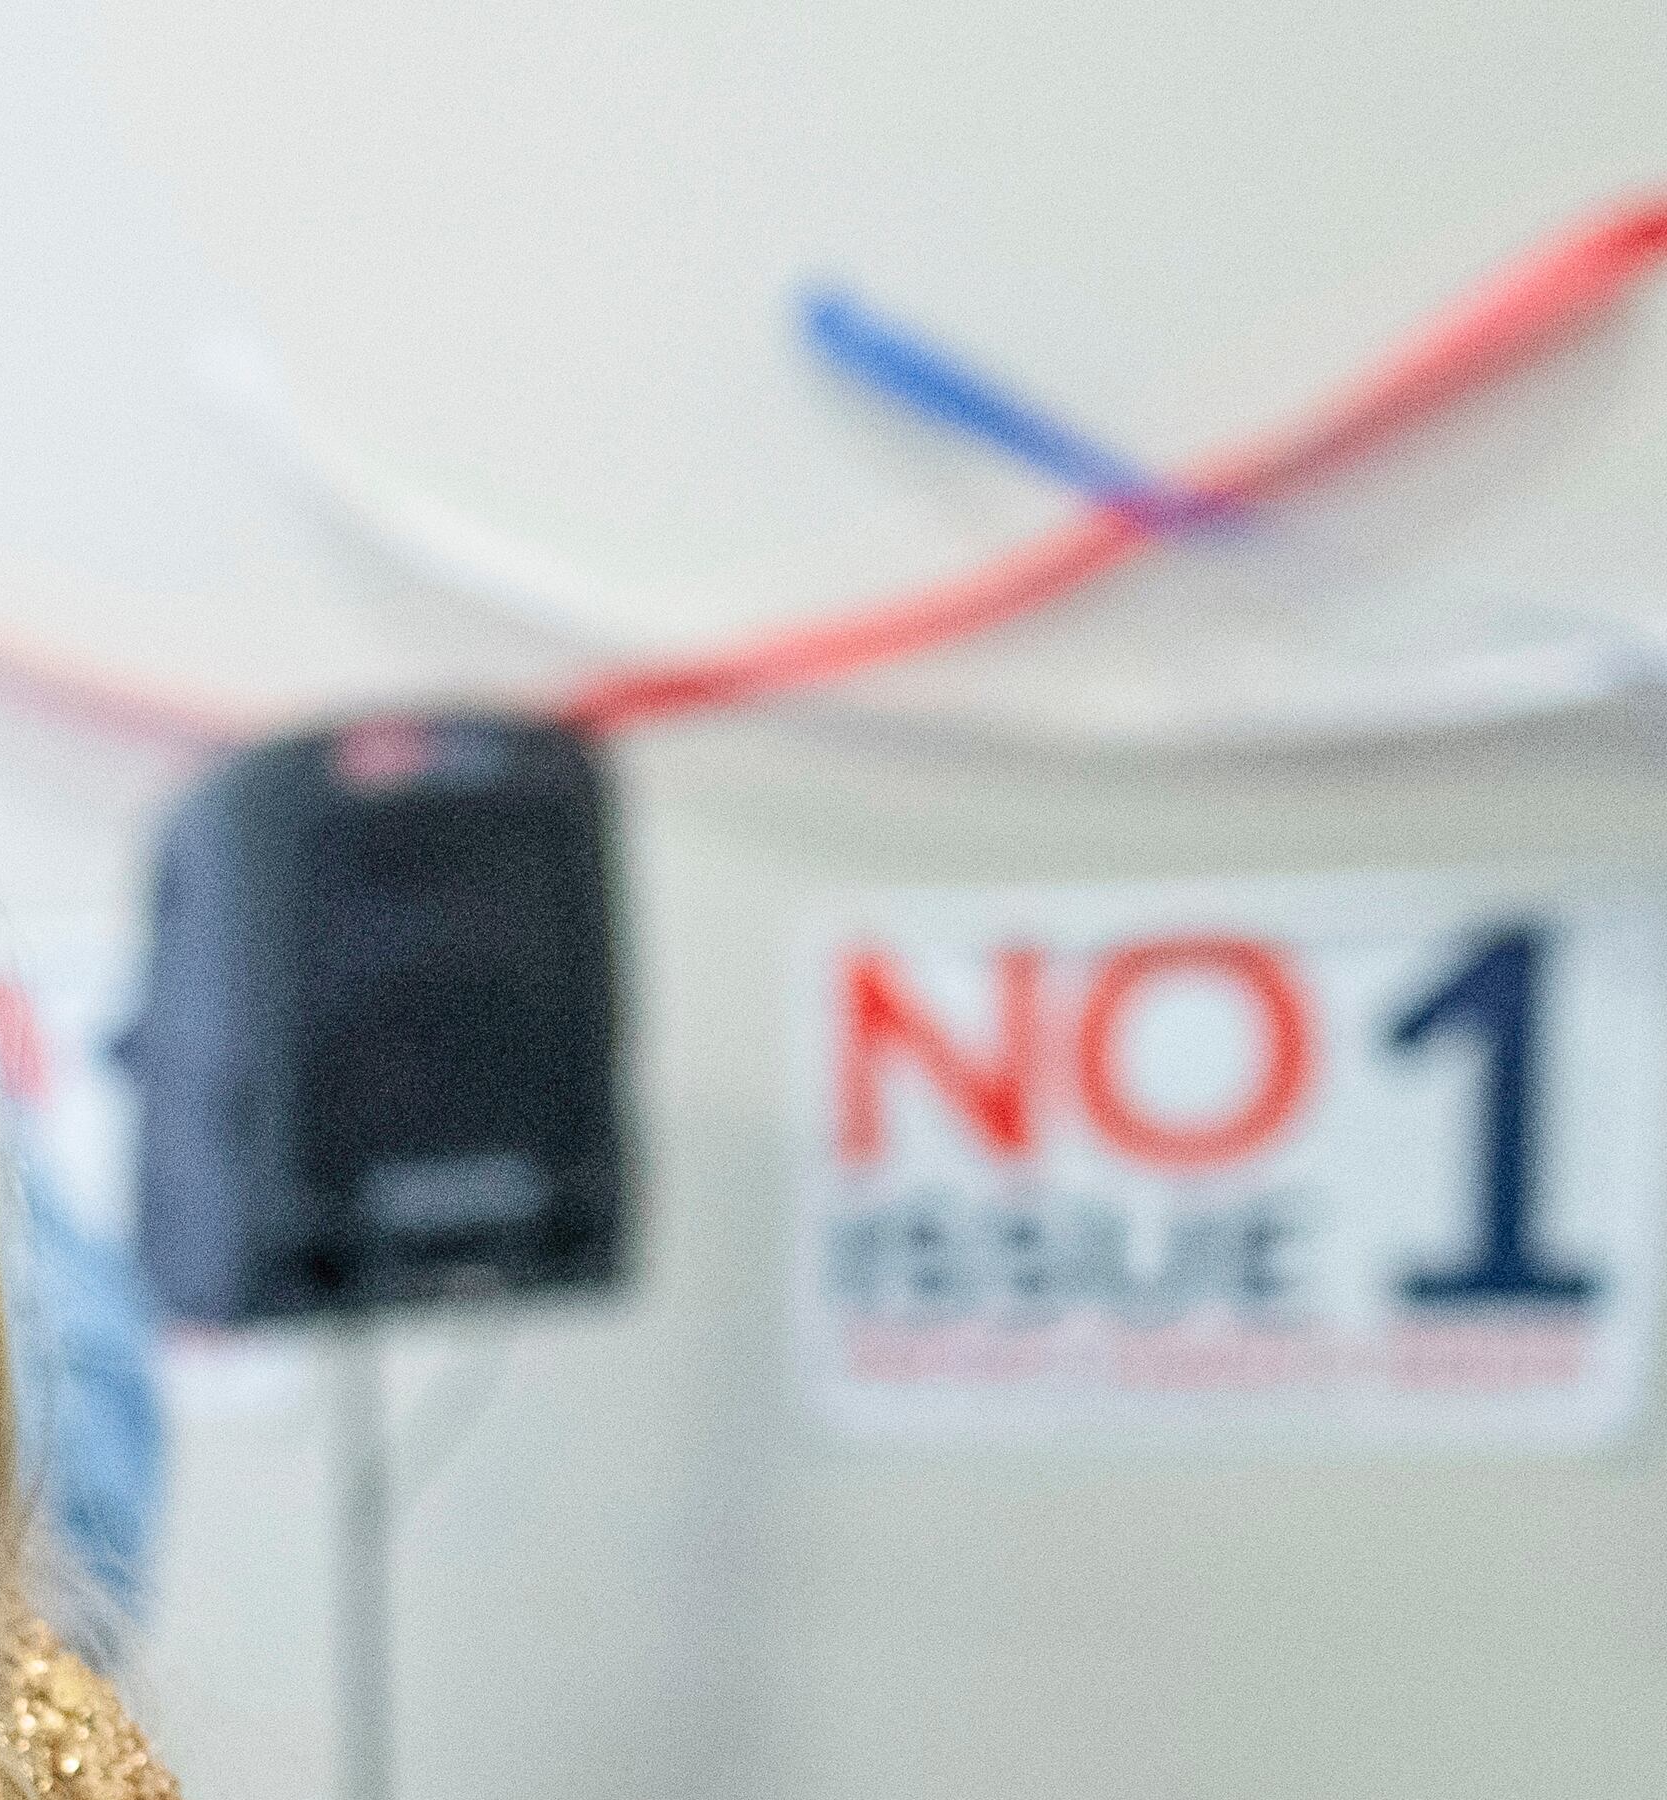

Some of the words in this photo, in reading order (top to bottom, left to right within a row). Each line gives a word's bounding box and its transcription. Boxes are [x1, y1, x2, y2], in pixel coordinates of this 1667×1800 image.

[834, 928, 1317, 1168] NO
[1389, 912, 1601, 1308] 1
[829, 1200, 1312, 1322] ISSUE
